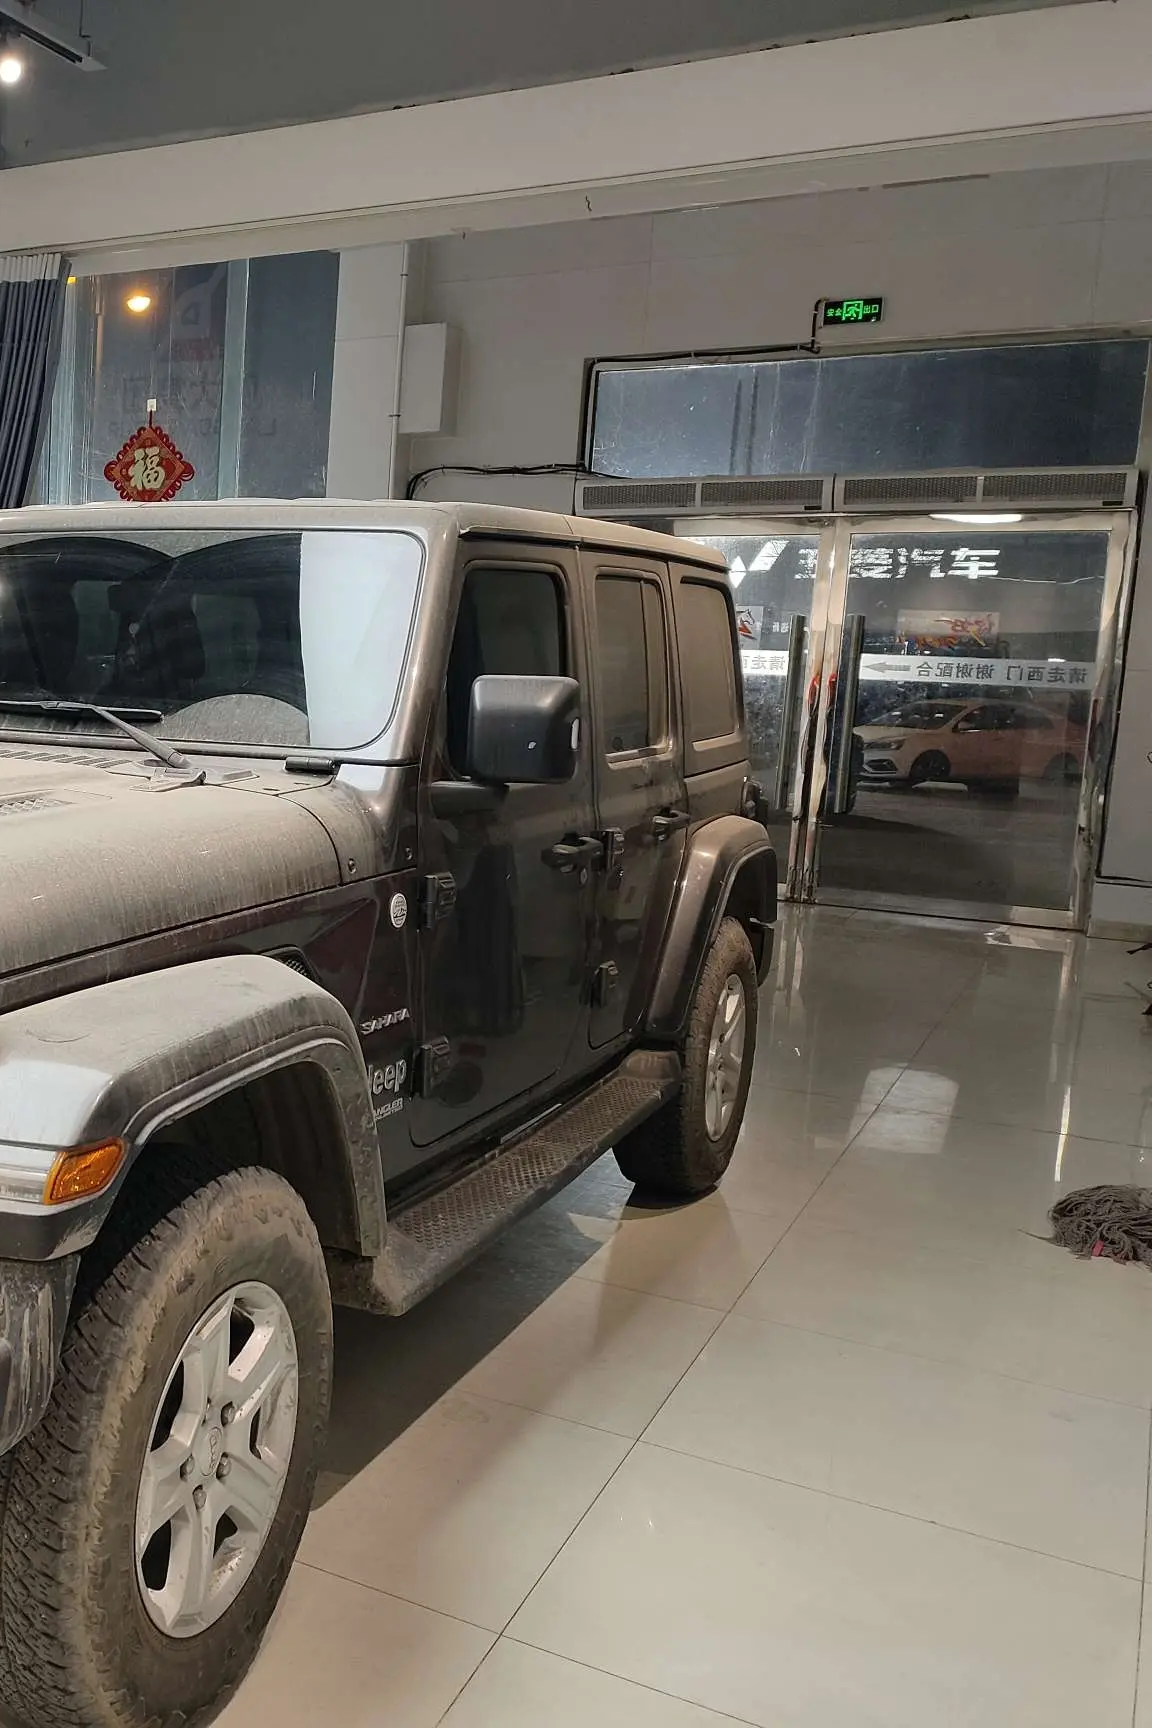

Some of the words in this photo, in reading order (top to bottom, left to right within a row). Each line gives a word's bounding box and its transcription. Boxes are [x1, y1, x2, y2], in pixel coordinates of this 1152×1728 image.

[827, 308, 842, 316] 安全
[864, 305, 879, 313] 出口
[127, 446, 166, 490] 福
[360, 1007, 410, 1035] SAHARA
